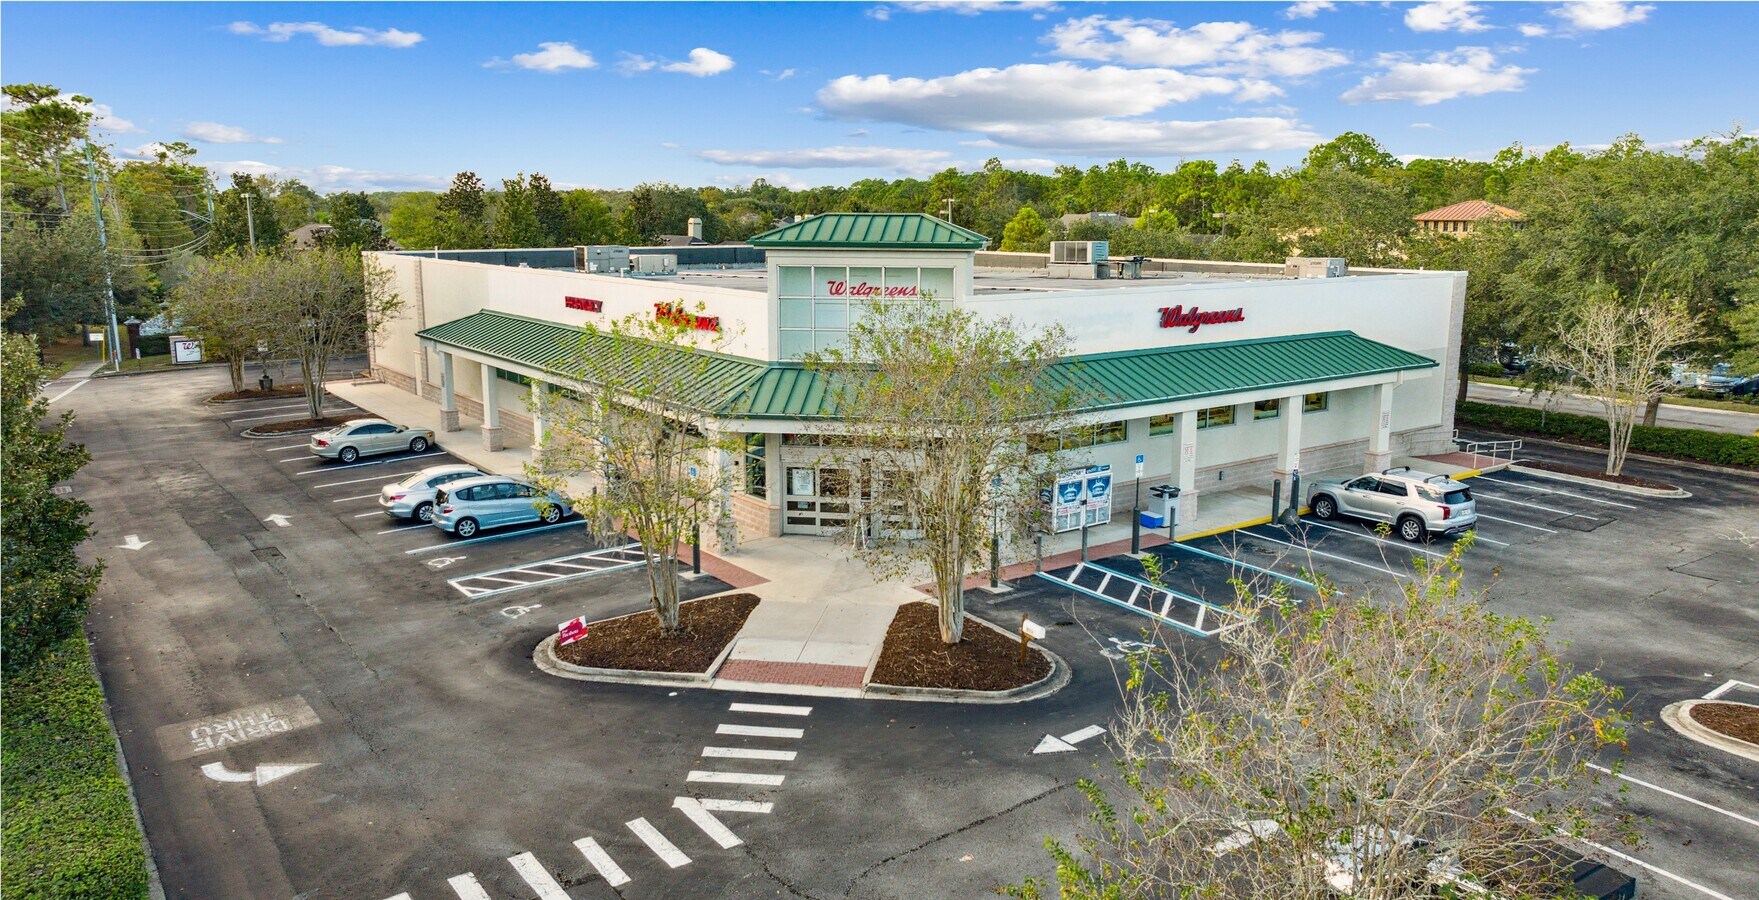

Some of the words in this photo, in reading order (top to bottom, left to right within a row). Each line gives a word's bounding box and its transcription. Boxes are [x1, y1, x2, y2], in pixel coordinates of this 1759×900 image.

[827, 280, 918, 297] Walgreens
[1158, 304, 1245, 333] Walgreens
[190, 711, 275, 740] THRU
[192, 718, 289, 752] DRIVE
